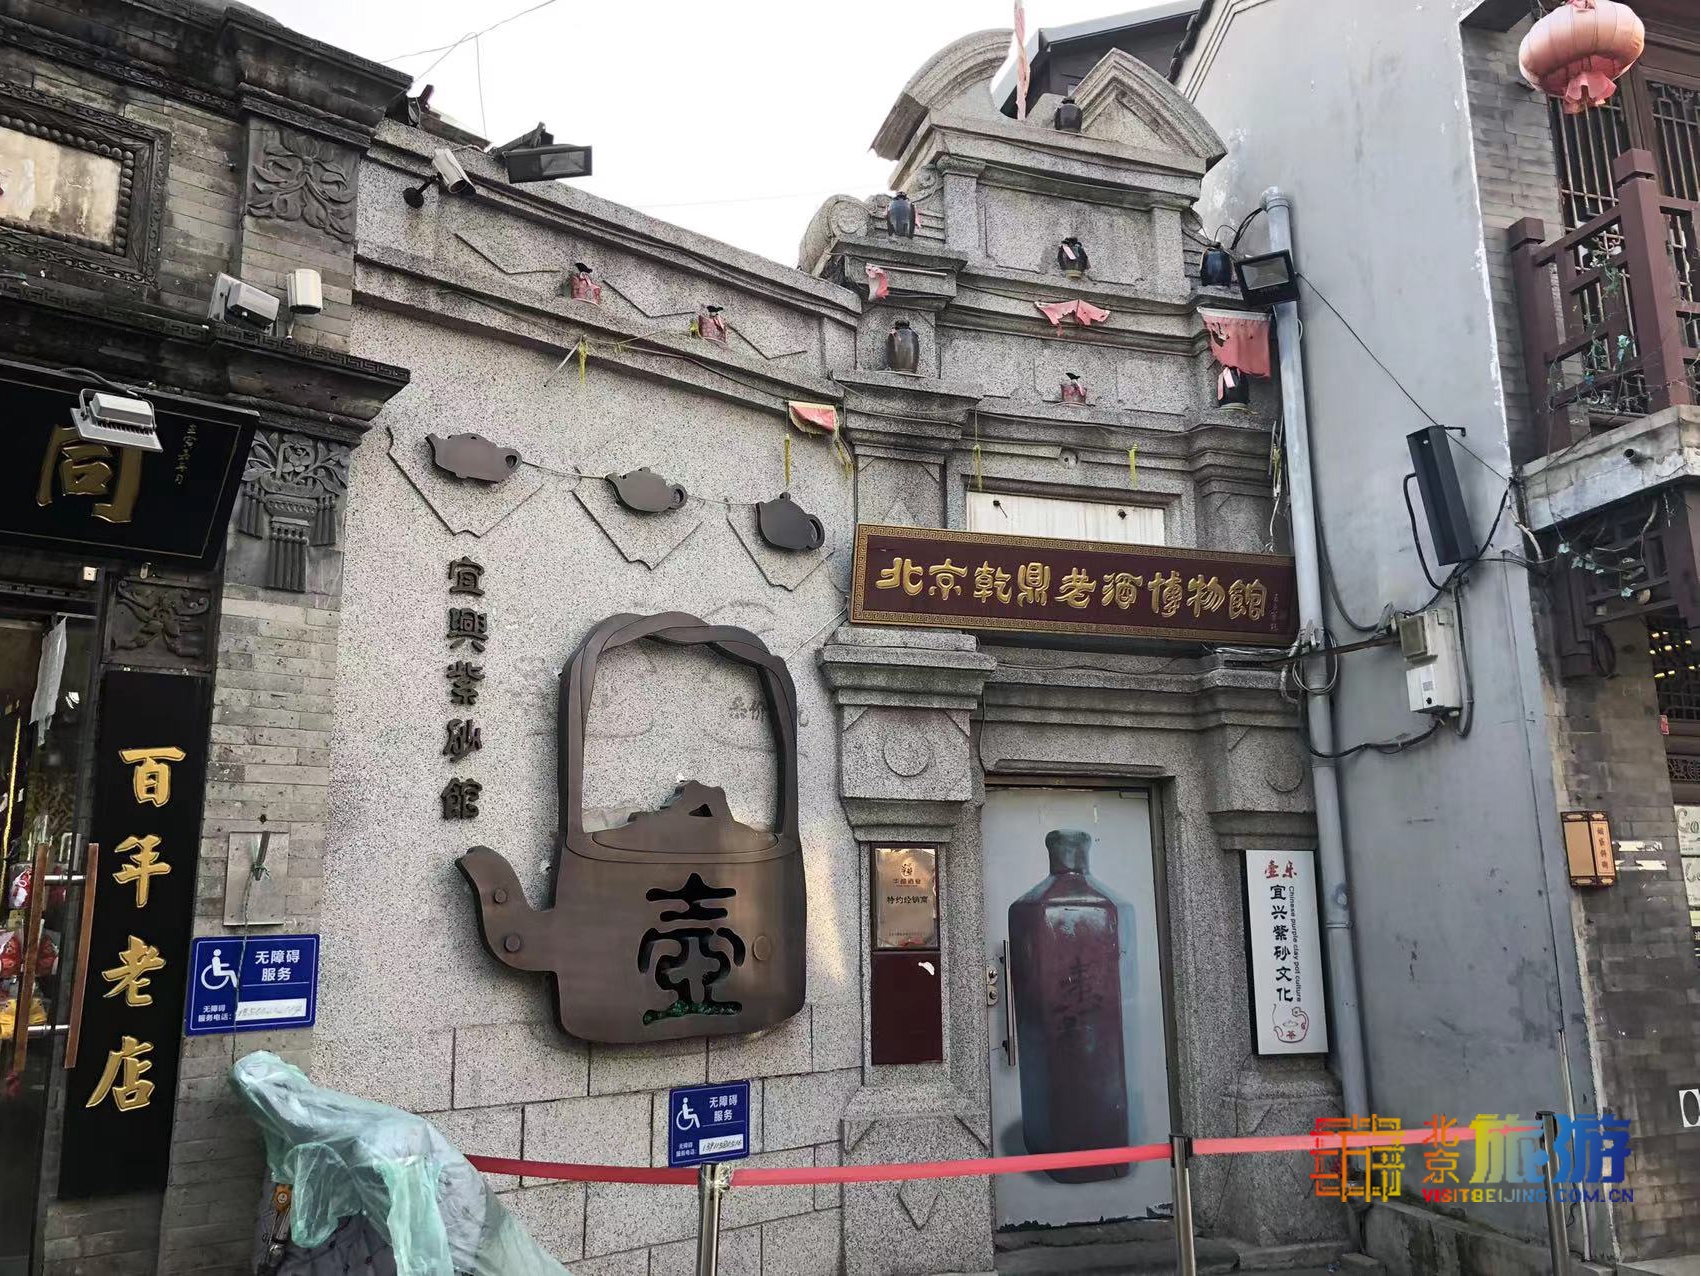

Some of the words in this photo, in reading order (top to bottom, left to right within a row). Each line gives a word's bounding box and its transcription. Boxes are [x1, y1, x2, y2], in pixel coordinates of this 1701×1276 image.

[85, 747, 186, 1112] 百年老店
[1270, 884, 1295, 1003] 宜兴紫砂文化
[255, 949, 300, 965] 无障碍
[261, 967, 292, 982] 服务
[203, 1004, 226, 1014] 无障碍
[709, 1095, 737, 1108] 无障碍
[713, 1109, 734, 1123] 服务
